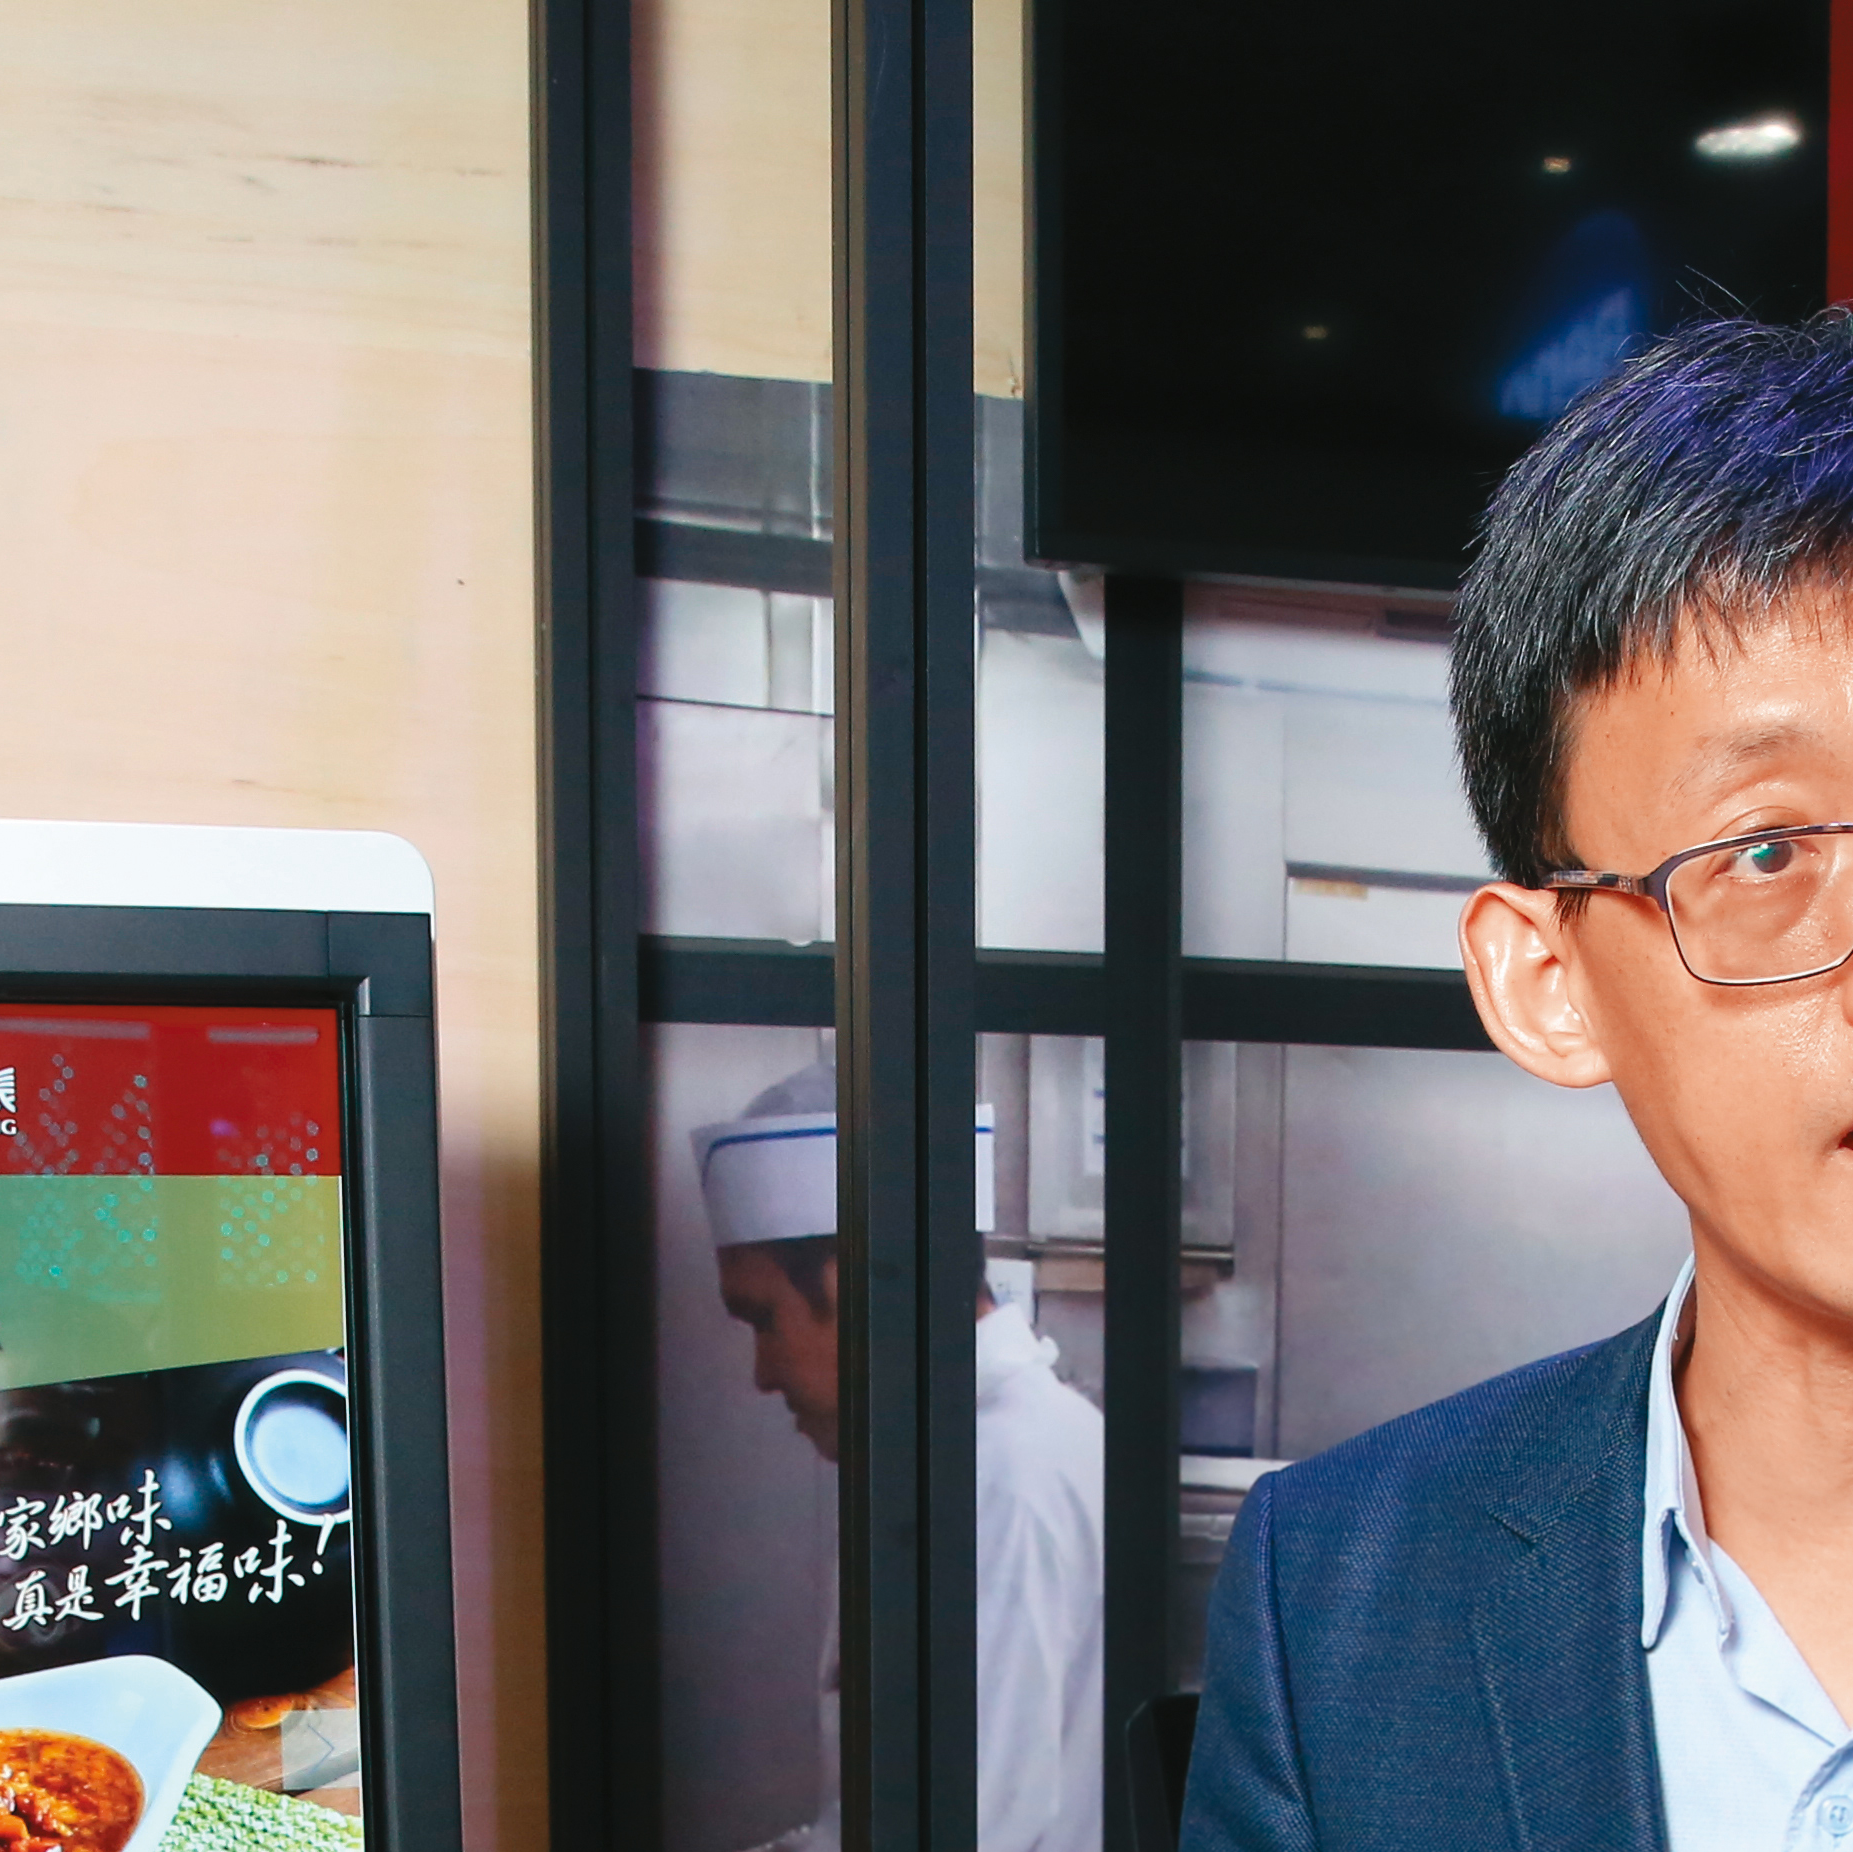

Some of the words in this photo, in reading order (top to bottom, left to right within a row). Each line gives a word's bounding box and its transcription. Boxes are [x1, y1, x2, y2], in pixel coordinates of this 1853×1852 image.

[1, 1514, 335, 1632] 真是幸福味!
